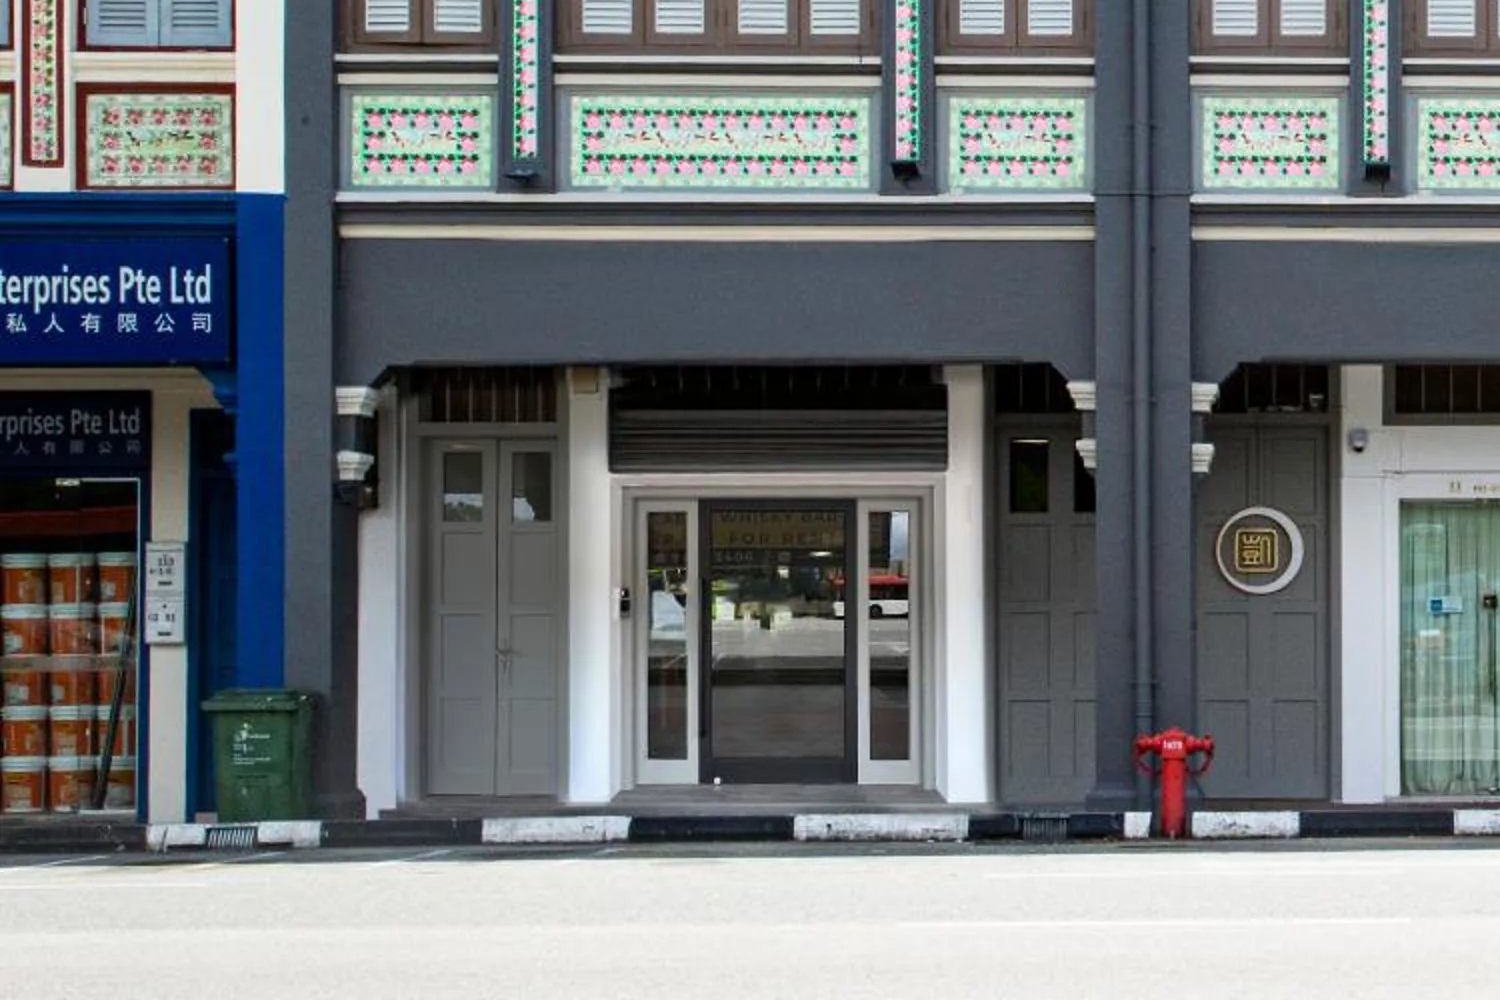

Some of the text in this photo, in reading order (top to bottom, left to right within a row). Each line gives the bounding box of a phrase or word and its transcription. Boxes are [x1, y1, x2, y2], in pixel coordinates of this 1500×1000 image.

[119, 265, 161, 304] Pte
[170, 263, 212, 304] Ltd
[70, 408, 103, 435] Pte
[108, 407, 140, 435] Ltd
